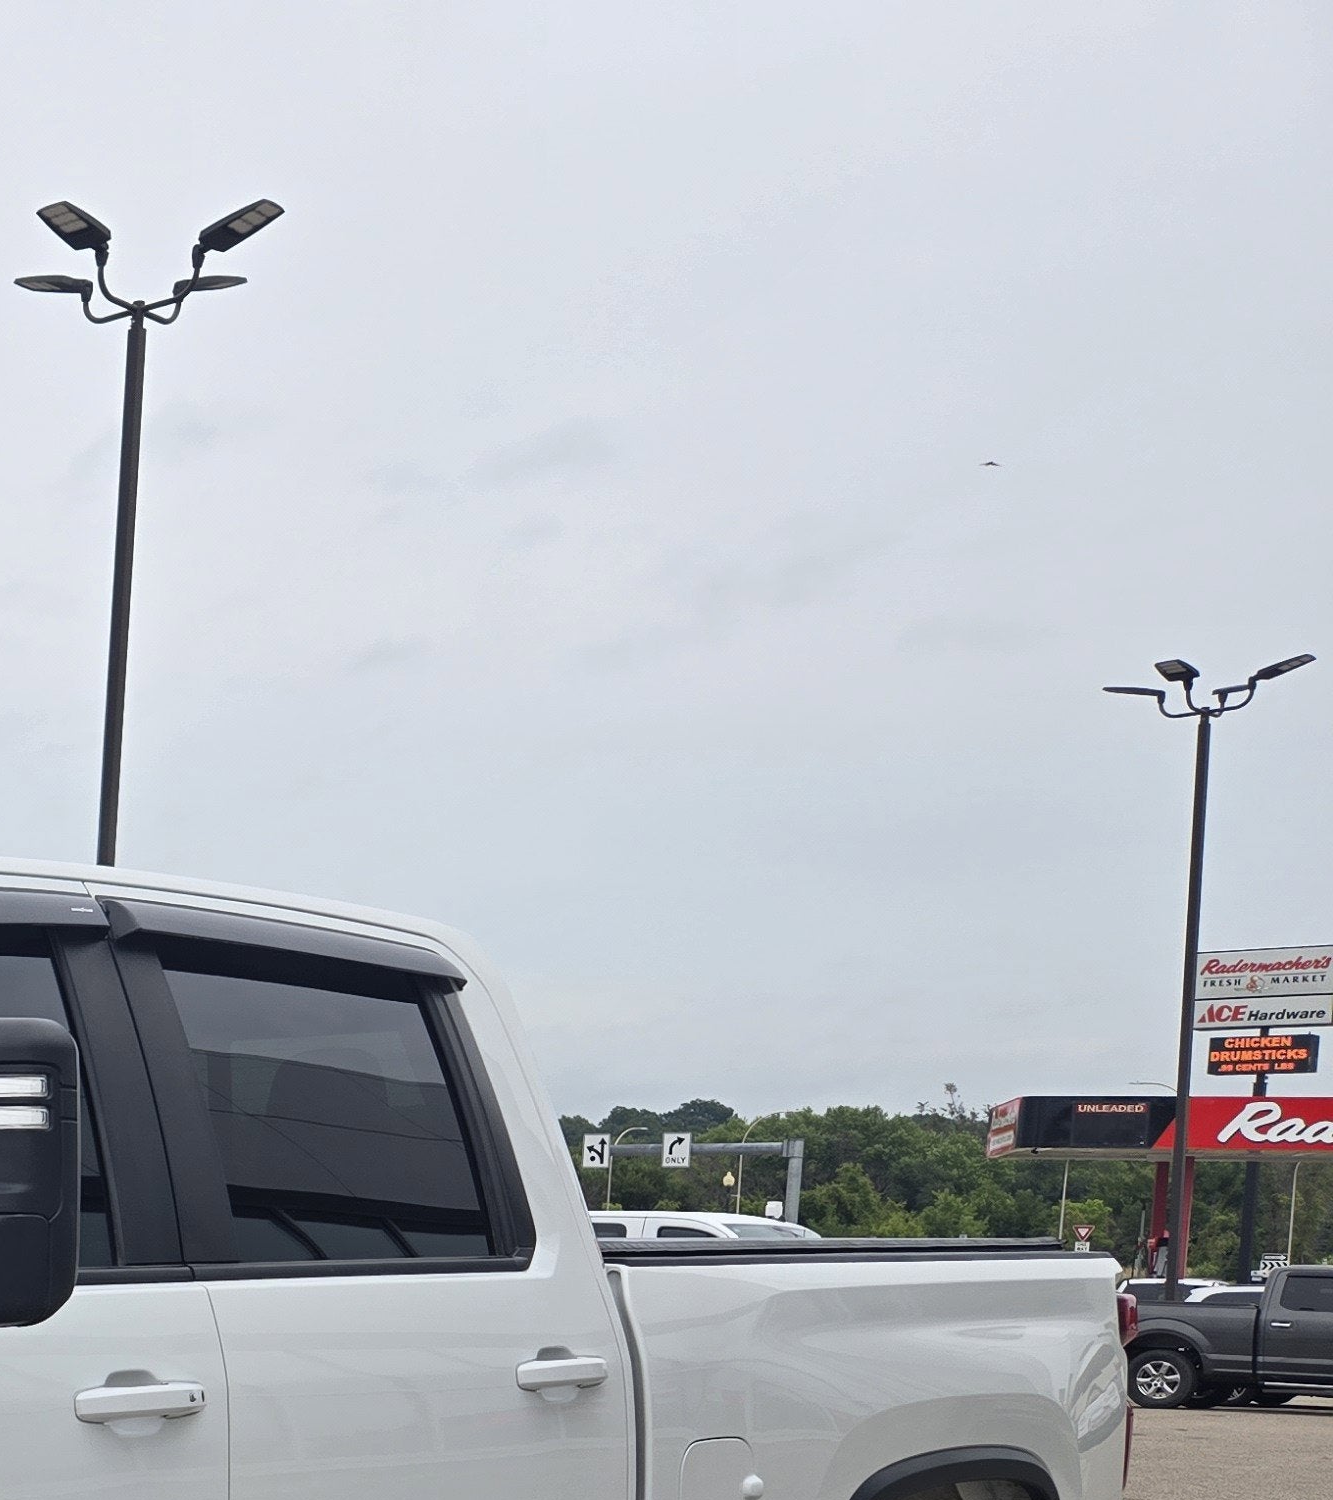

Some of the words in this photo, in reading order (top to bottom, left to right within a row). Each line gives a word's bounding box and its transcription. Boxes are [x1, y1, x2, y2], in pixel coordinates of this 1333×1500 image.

[1200, 956, 1332, 976] Radermacher's
[1203, 978, 1241, 988] FRESH
[1271, 974, 1327, 984] MARKET
[1197, 1003, 1248, 1024] ACE
[1247, 1008, 1326, 1021] Hardware
[1224, 1036, 1292, 1049] CHICKEN
[1210, 1048, 1308, 1062] DRUMSTICKS
[1235, 1063, 1270, 1071] CENTS
[1077, 1103, 1145, 1113] UNLEADED
[665, 1156, 686, 1164] ONLY
